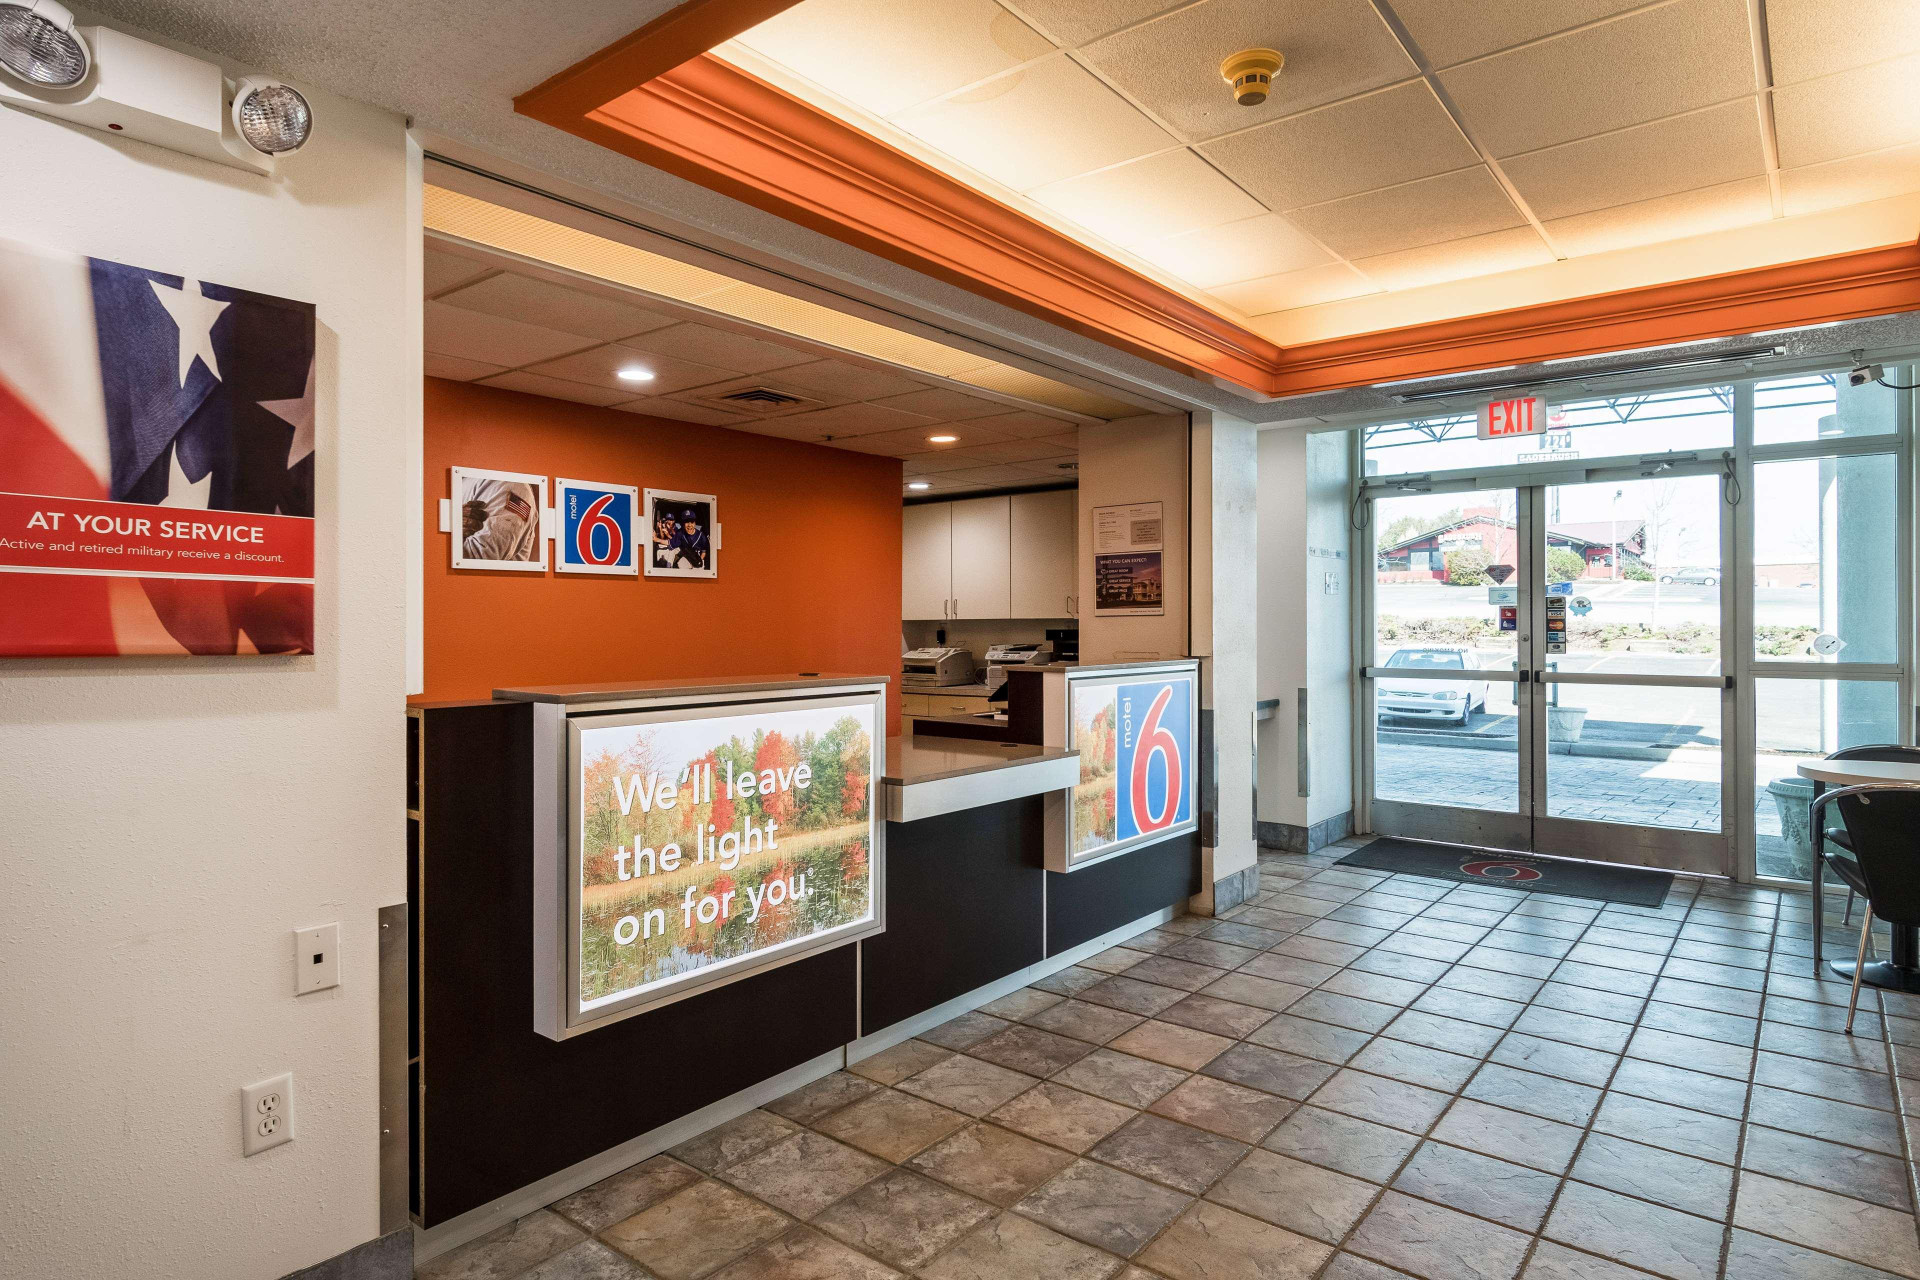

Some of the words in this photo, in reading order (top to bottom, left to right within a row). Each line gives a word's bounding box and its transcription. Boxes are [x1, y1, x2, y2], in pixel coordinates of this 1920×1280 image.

[1488, 397, 1536, 435] EXIT
[0, 537, 45, 551] Active
[49, 541, 75, 552] and
[79, 543, 124, 555] retired
[127, 545, 174, 560] military
[177, 548, 221, 560] receive
[224, 552, 231, 560] a
[234, 551, 285, 563] discount.
[26, 511, 65, 531] AT
[73, 514, 151, 537] YOUR
[159, 520, 265, 544] SERVICE
[569, 494, 577, 520] motel
[576, 493, 623, 566] 6
[613, 762, 711, 817] We'll
[727, 760, 812, 800] leave
[1123, 697, 1132, 748] motel
[1130, 684, 1182, 836] 6
[613, 834, 682, 882] the
[696, 815, 779, 871] light
[613, 907, 666, 946] on
[681, 886, 736, 929] for
